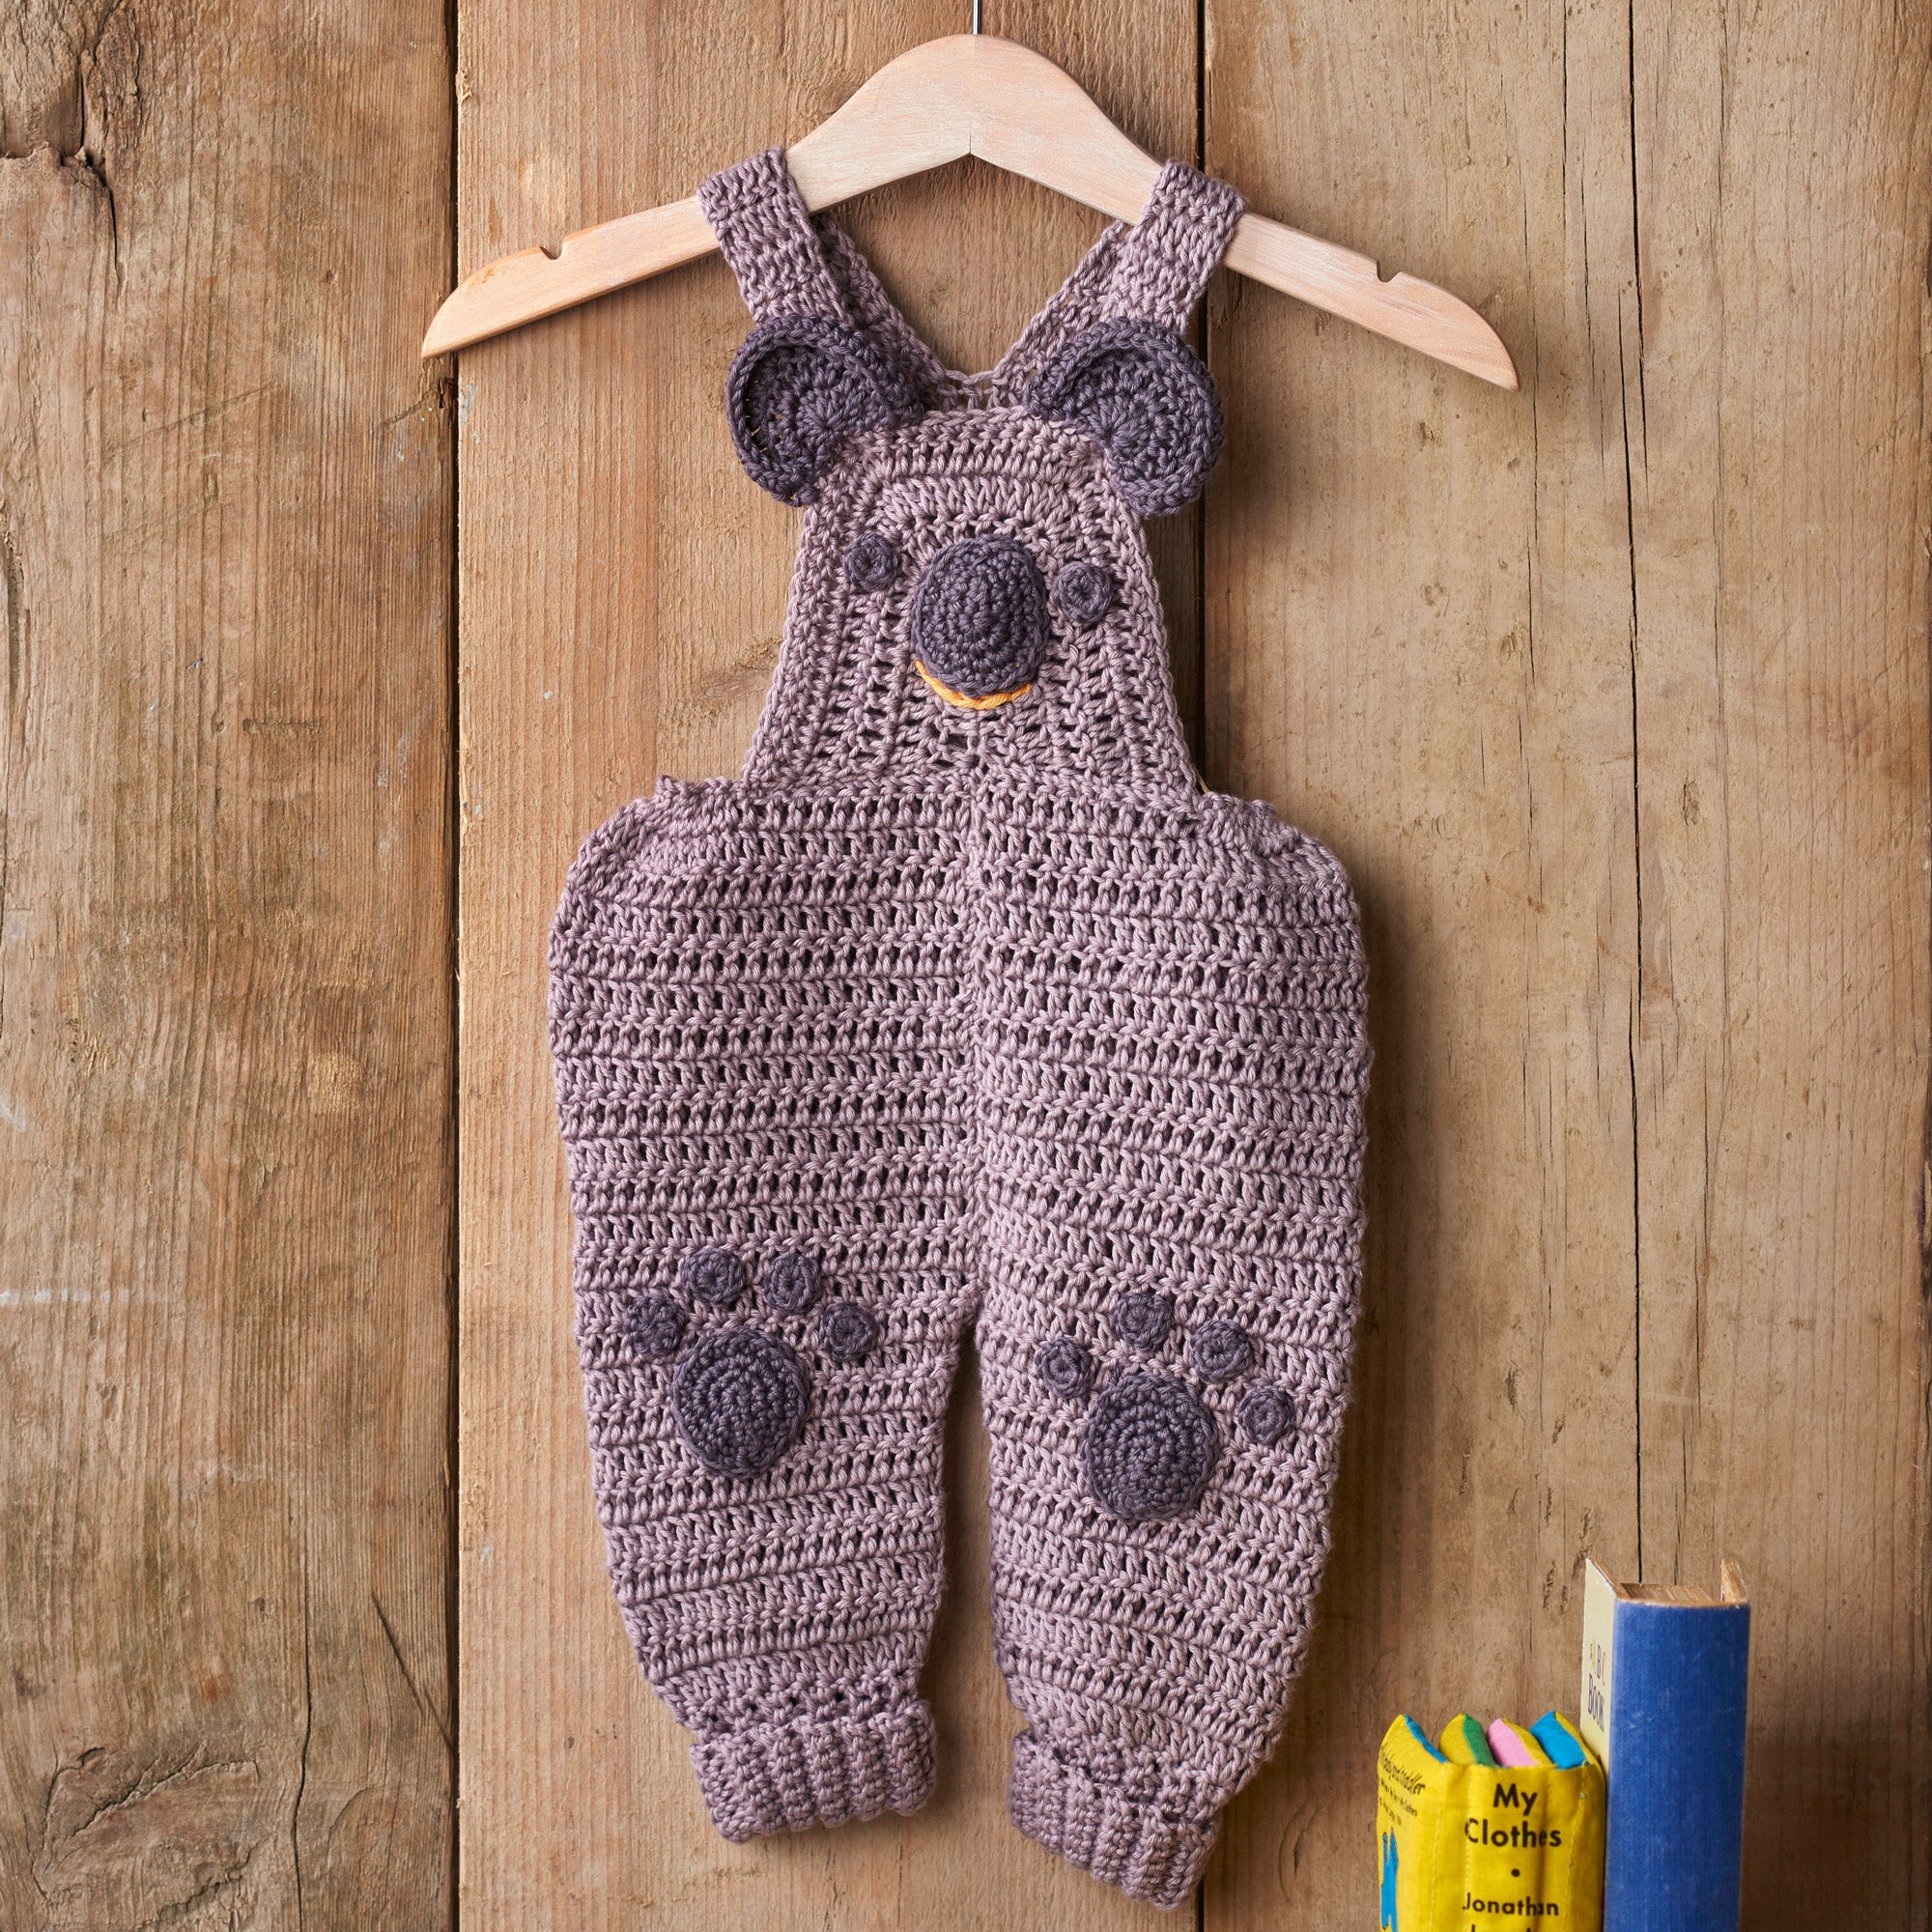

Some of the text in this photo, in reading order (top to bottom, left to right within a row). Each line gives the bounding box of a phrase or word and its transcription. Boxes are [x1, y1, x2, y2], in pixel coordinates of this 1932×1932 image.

[1588, 1673, 1605, 1732] BOOK
[1492, 1783, 1538, 1816] My
[1464, 1818, 1562, 1847] Clothes
[1462, 1892, 1559, 1917] Jonathan
